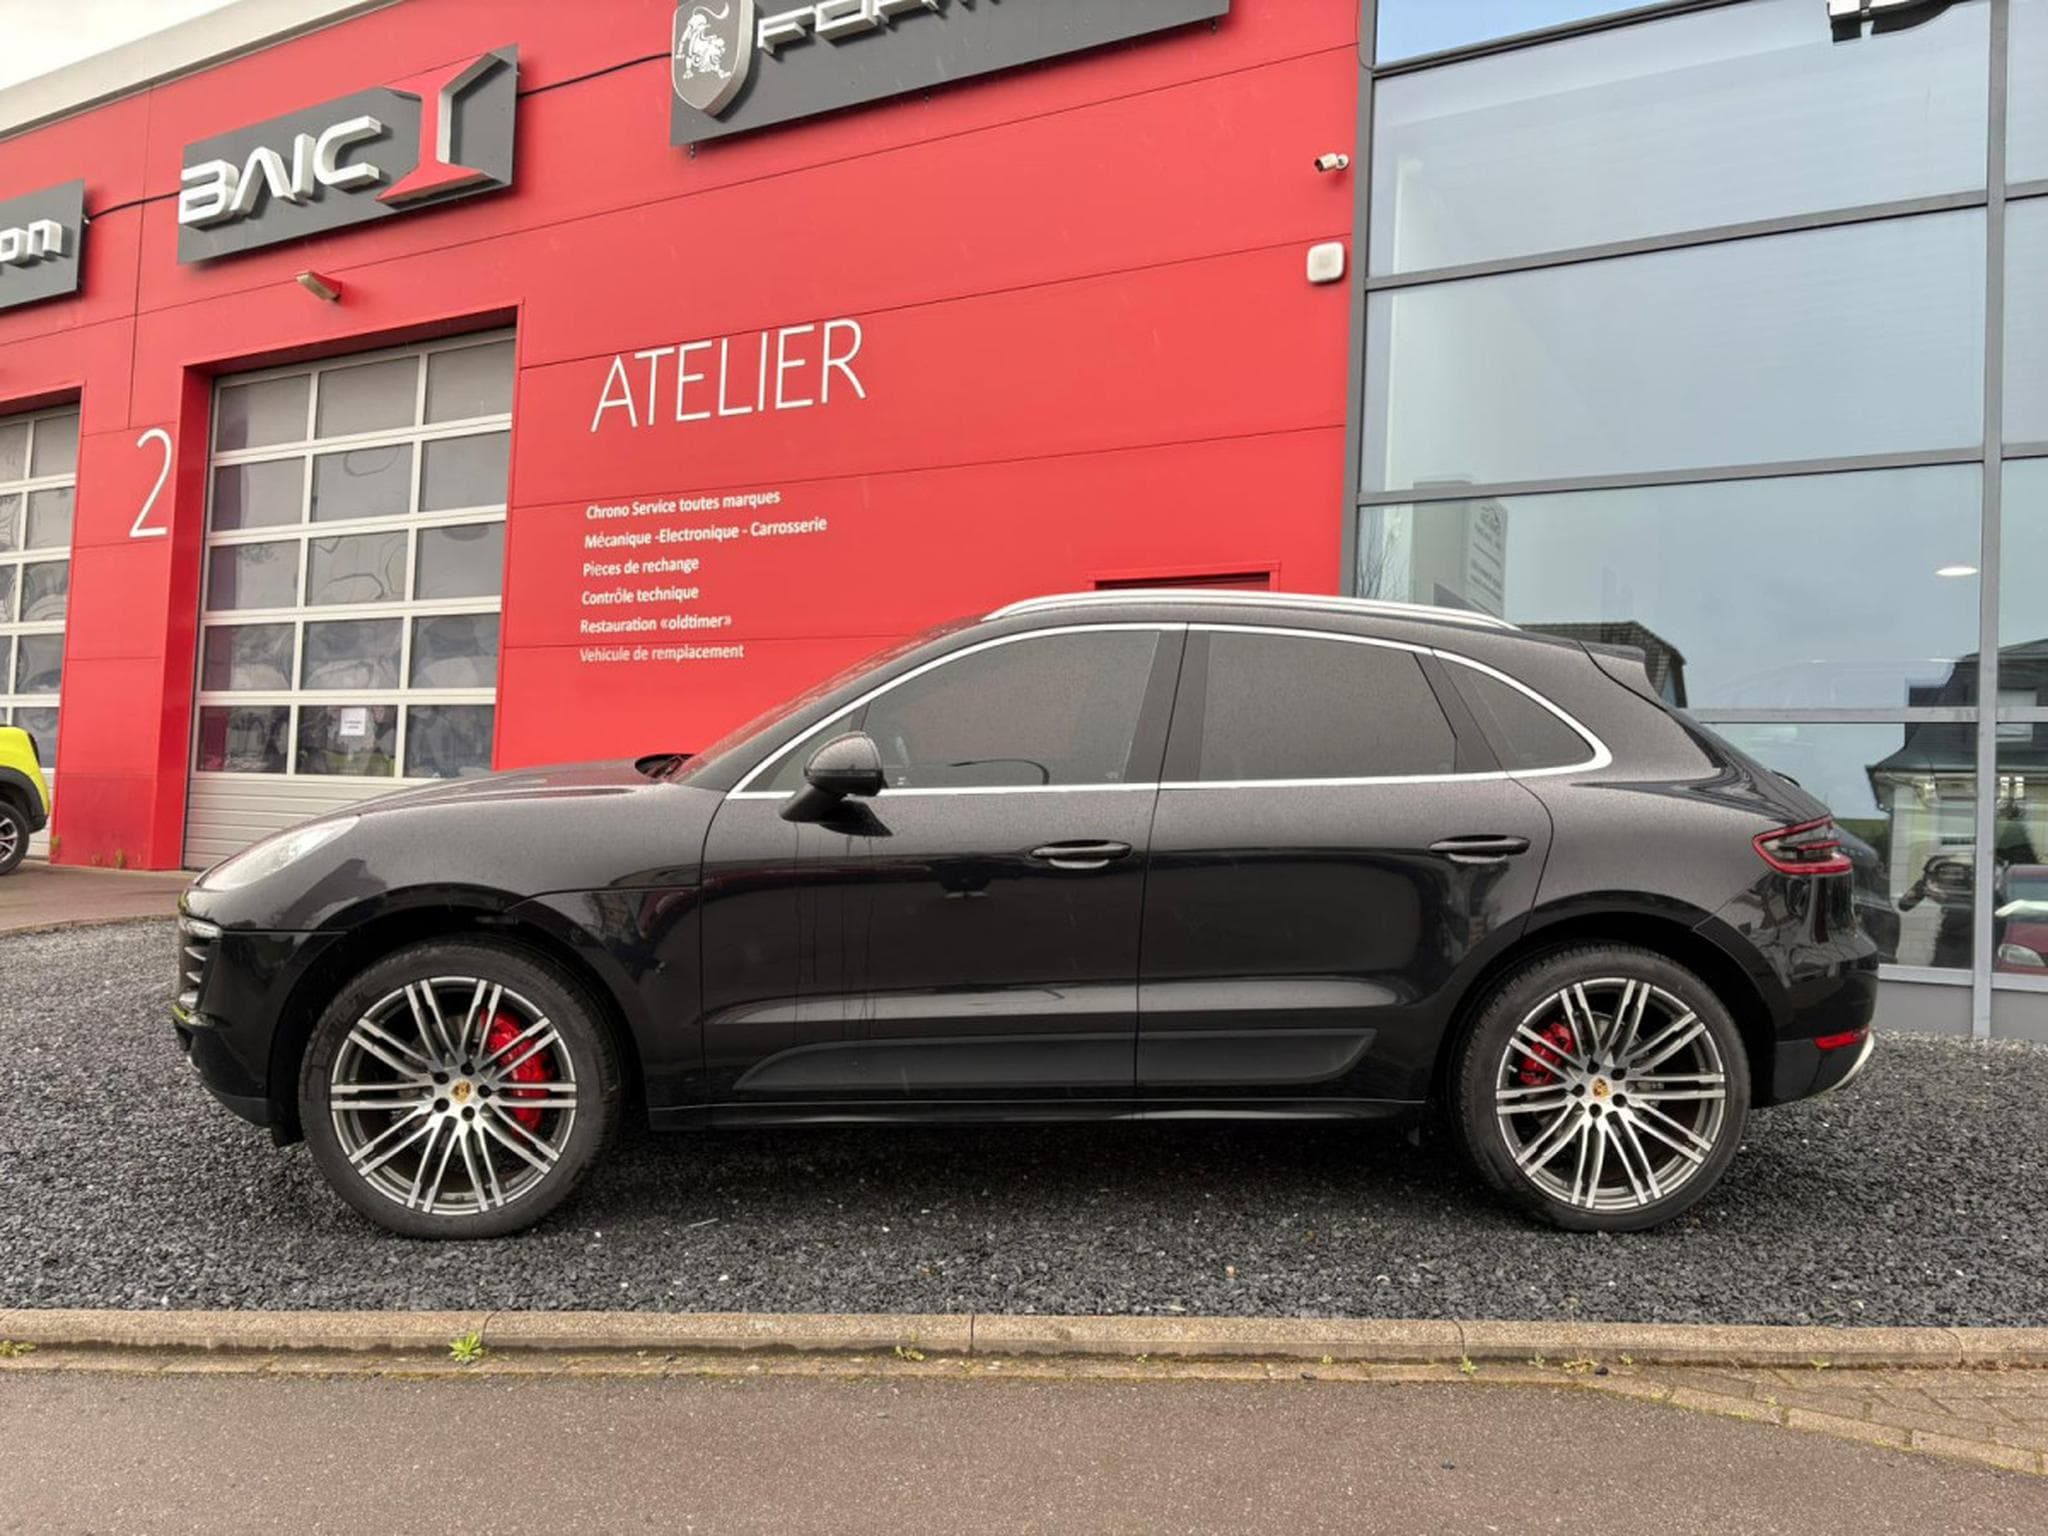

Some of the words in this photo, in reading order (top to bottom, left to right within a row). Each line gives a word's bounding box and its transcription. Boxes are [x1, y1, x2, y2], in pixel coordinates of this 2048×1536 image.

[178, 115, 382, 224] BAIC
[590, 318, 866, 433] ATELIER
[129, 428, 172, 538] 2
[586, 504, 630, 519] Chrono
[632, 499, 676, 516] Service
[679, 496, 720, 512] toutes
[722, 491, 781, 509] marques
[584, 531, 652, 548] Mécanique
[751, 516, 828, 537] Carrosserie
[624, 560, 640, 575] de
[642, 557, 700, 574] rechange
[582, 588, 635, 606] Contrôle
[637, 586, 700, 603] technique
[580, 617, 657, 634] Restauration
[633, 645, 649, 660] de
[651, 643, 745, 662] remplacement
